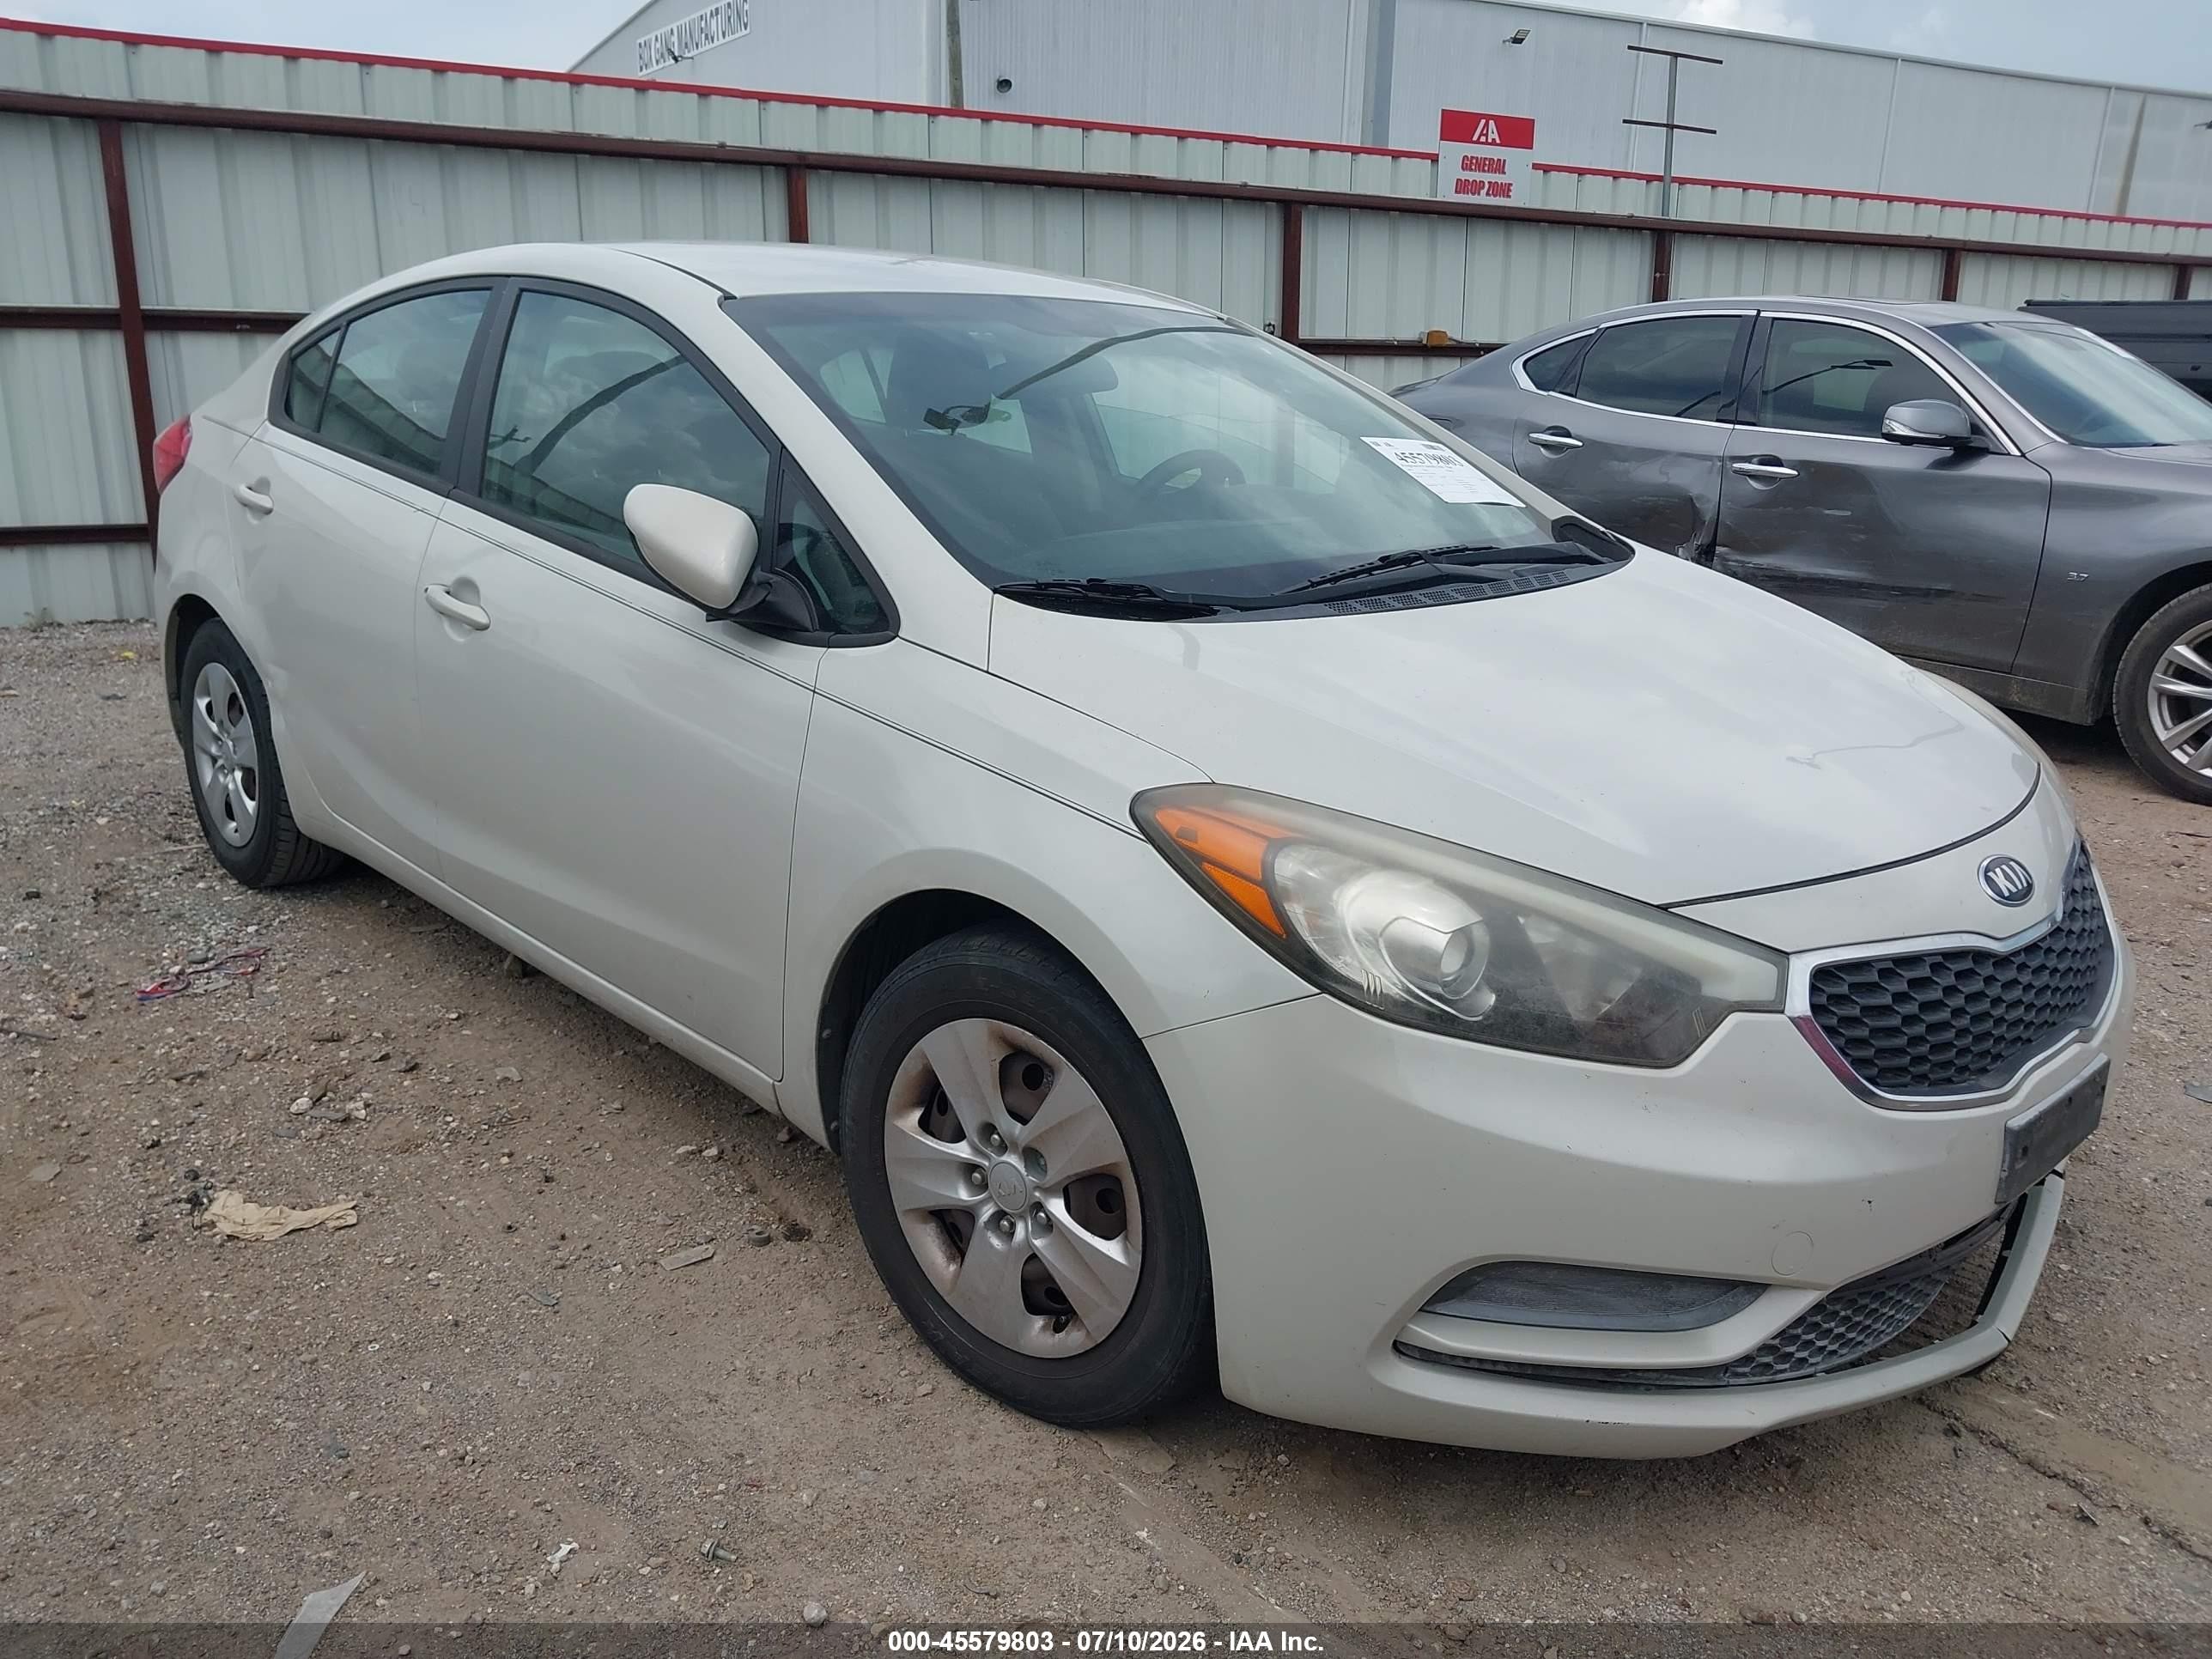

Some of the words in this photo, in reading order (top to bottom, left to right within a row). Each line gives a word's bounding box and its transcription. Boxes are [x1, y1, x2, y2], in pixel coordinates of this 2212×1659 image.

[638, 38, 653, 72] BOX
[677, 0, 749, 55] MANUFACTURING
[1461, 155, 1507, 175] GENERAL
[1455, 178, 1485, 198] DROP
[1486, 181, 1513, 199] ZONE
[1394, 452, 1464, 467] 45579803
[1986, 860, 2033, 897] KIA
